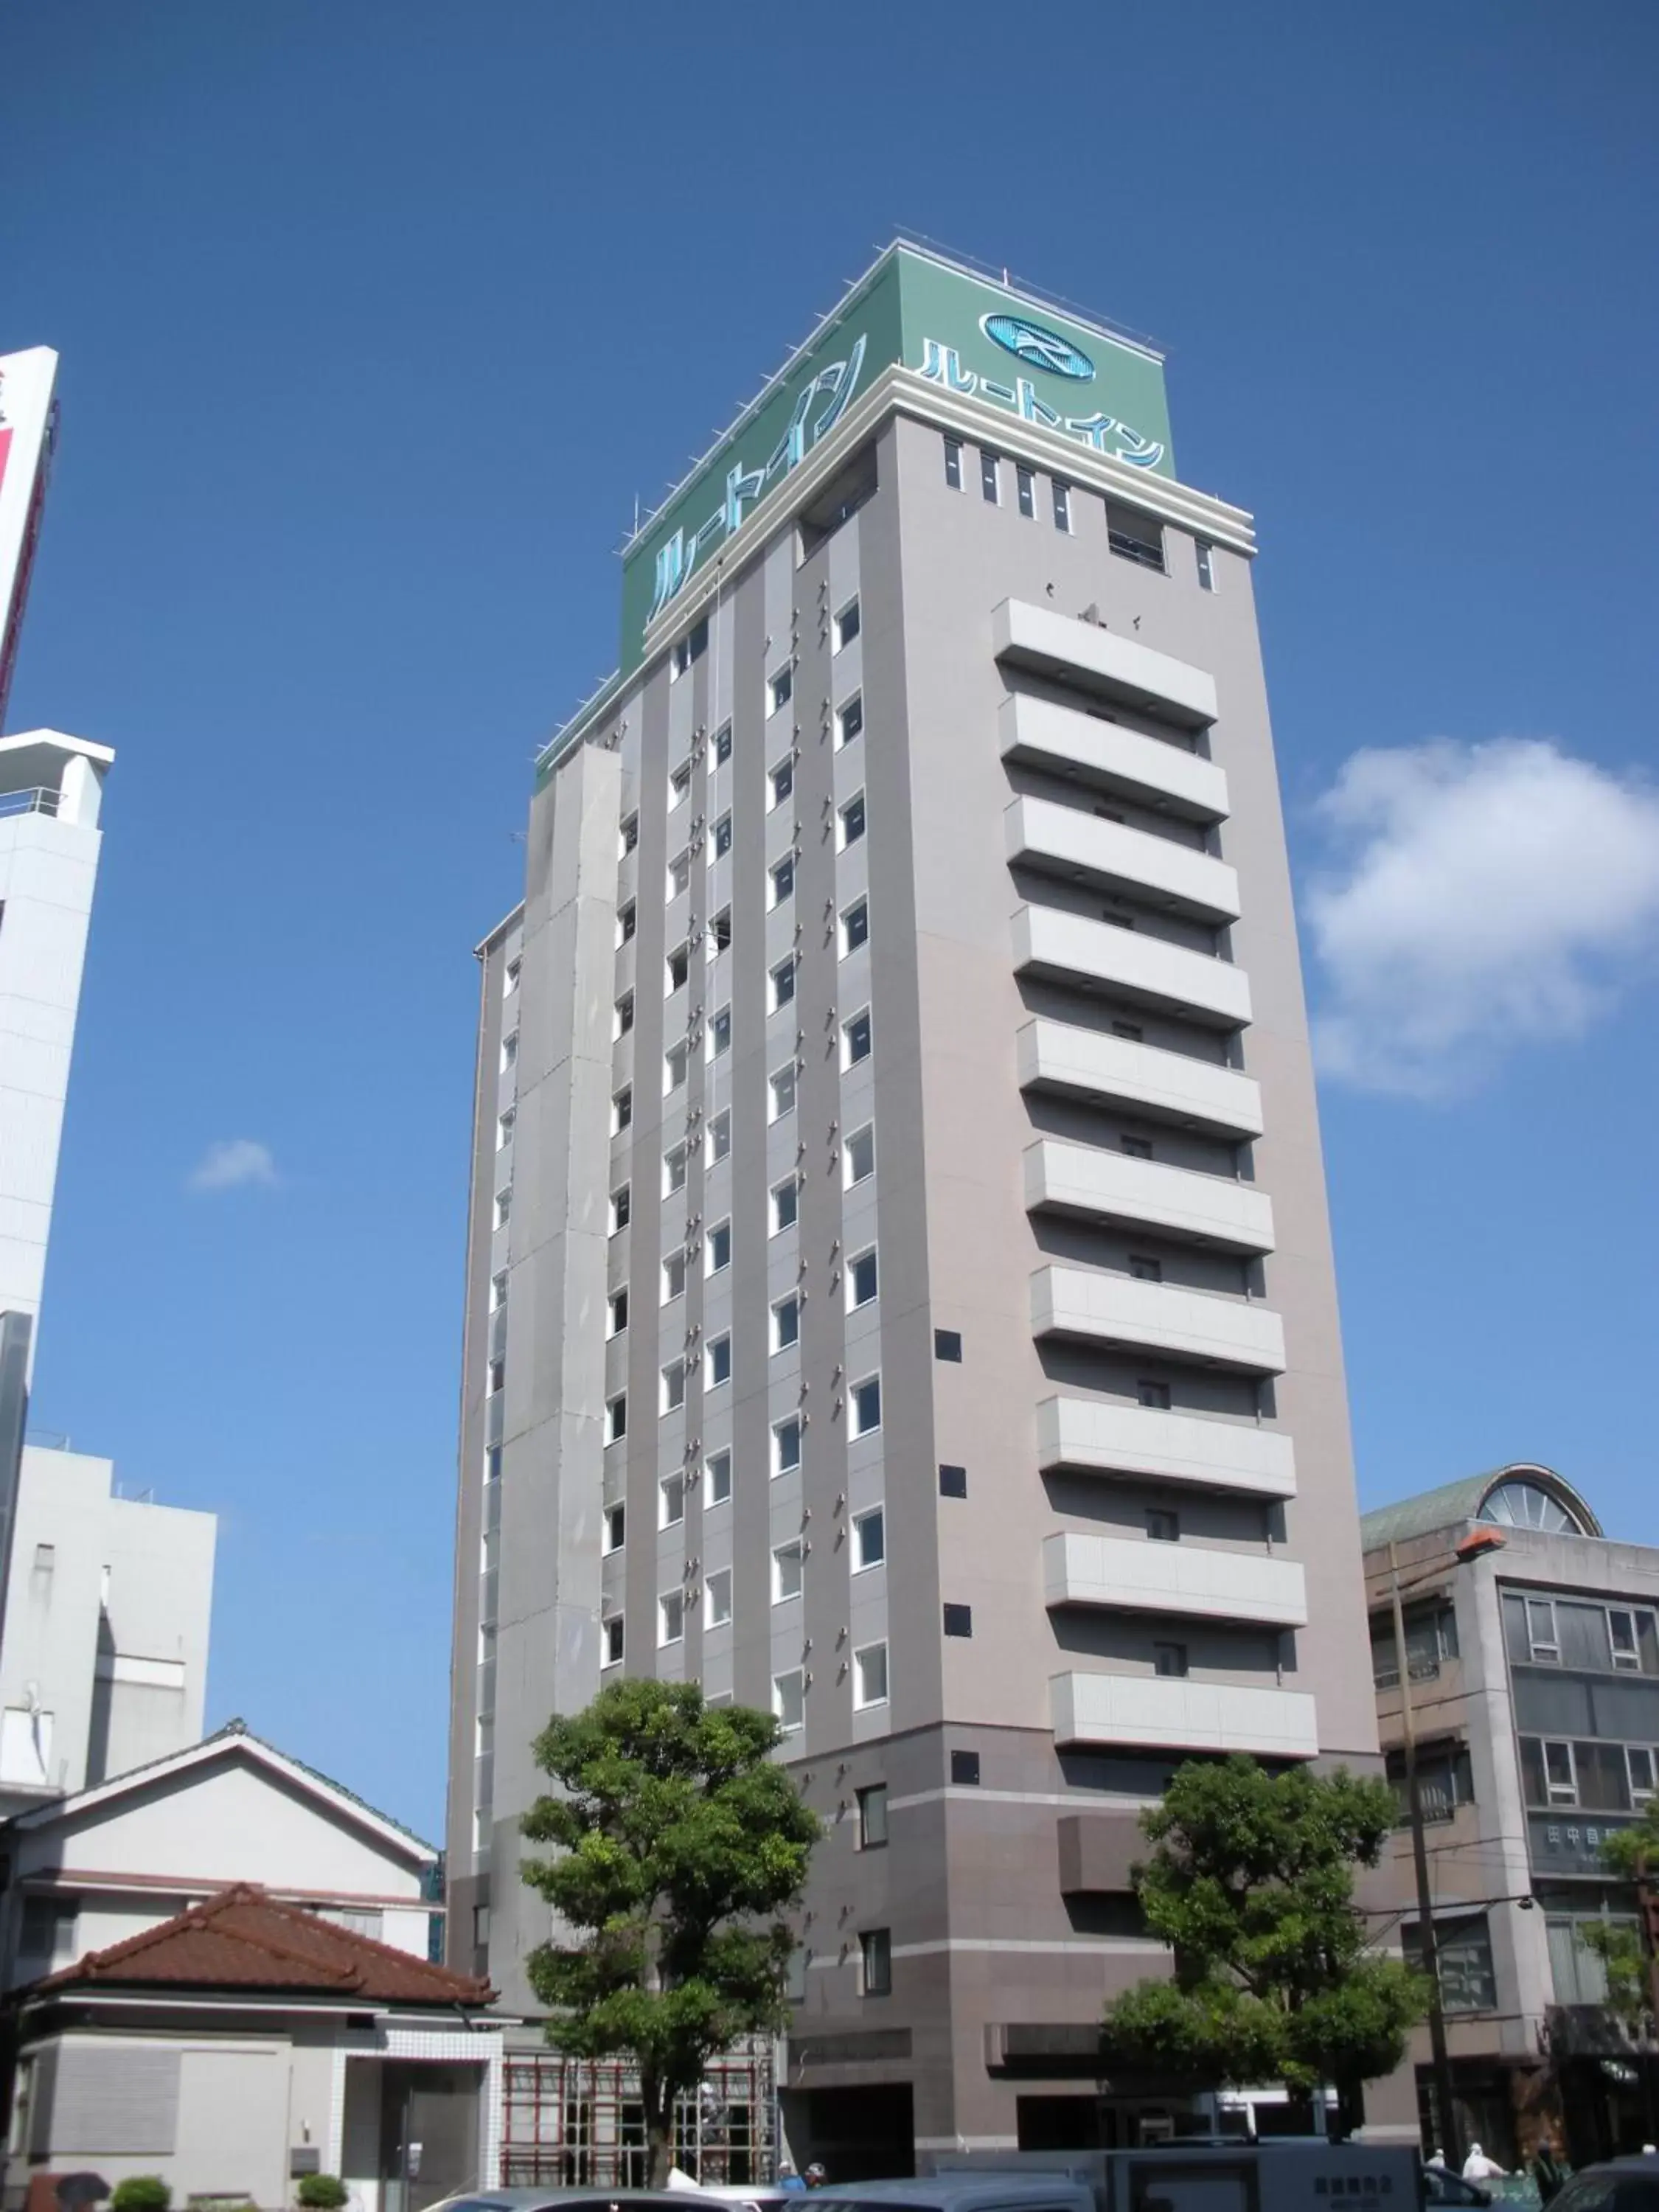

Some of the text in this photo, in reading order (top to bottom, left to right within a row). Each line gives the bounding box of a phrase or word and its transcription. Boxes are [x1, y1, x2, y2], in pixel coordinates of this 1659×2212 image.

[647, 333, 867, 625] ルートイン
[914, 337, 1165, 470] ルートイン
